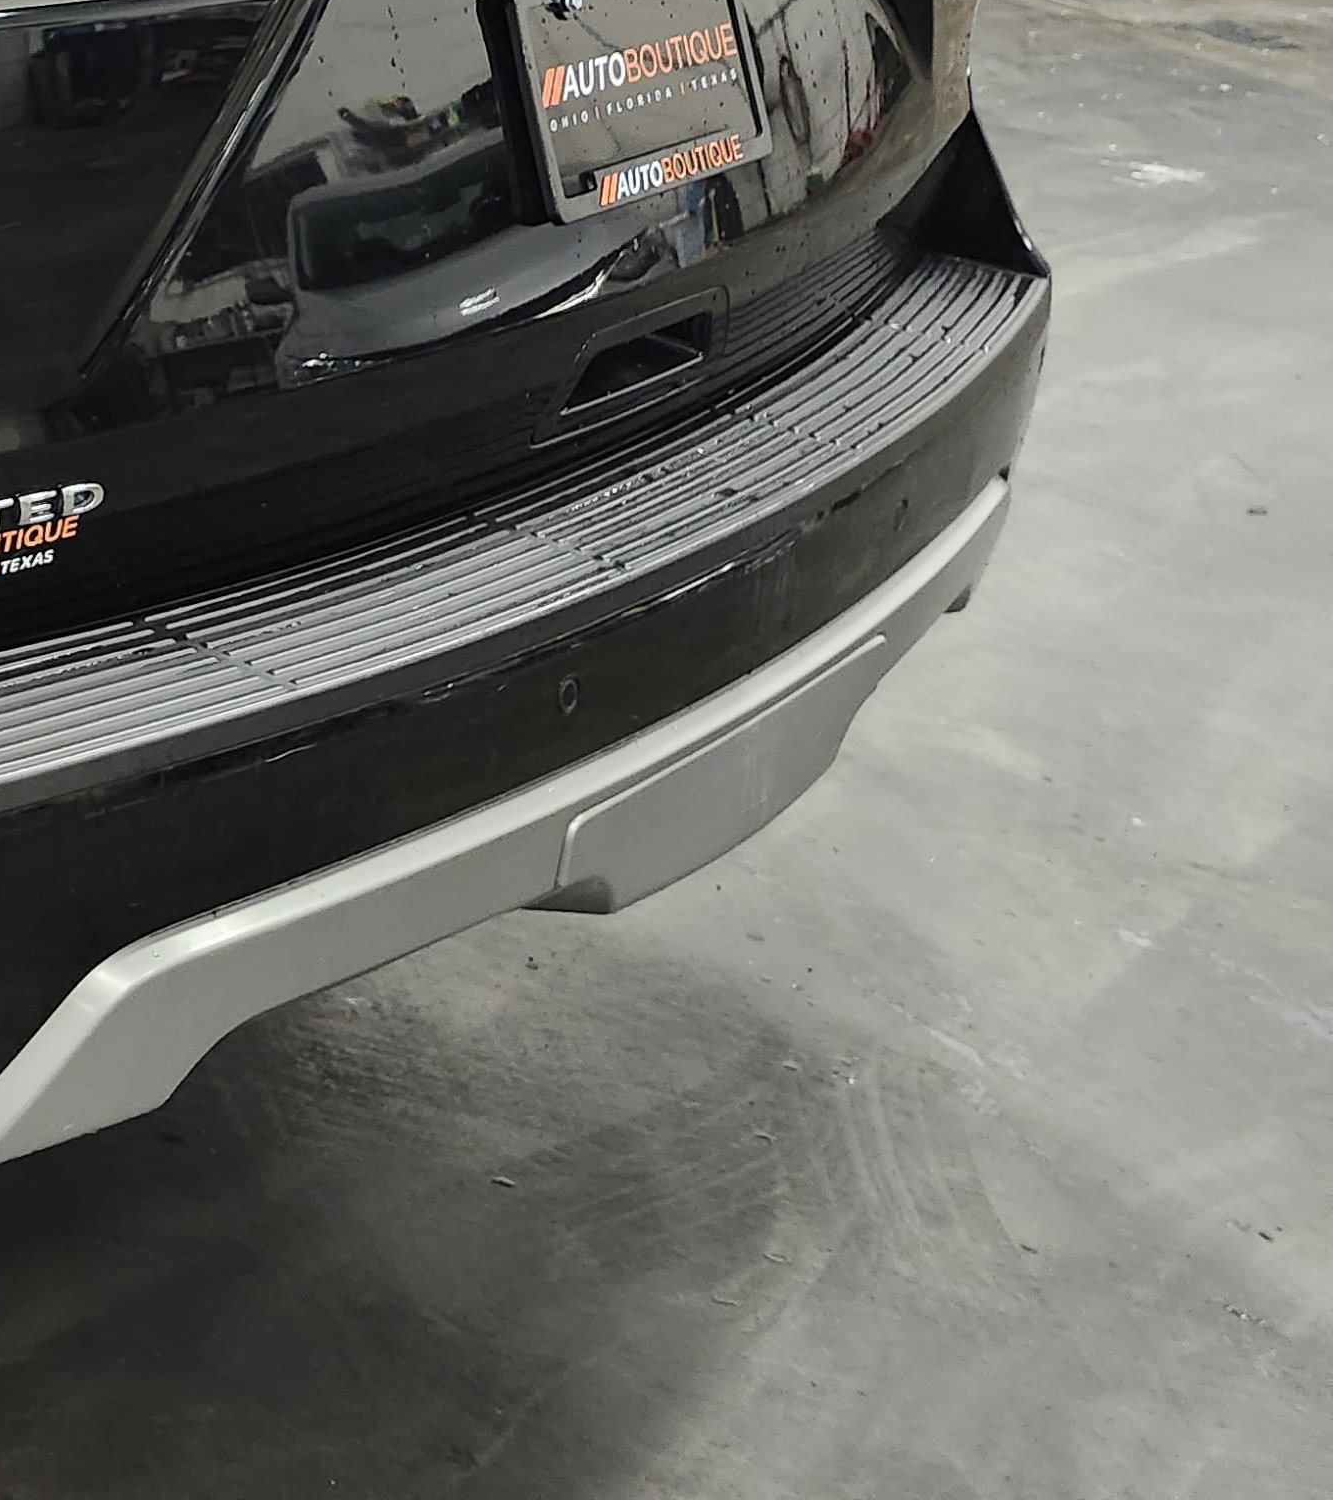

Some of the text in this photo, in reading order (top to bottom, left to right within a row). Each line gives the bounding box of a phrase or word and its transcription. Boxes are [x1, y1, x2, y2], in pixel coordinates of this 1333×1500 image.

[550, 67, 737, 132] OHIO FLORIDA TEXAS
[0, 549, 55, 576] TEXAS
